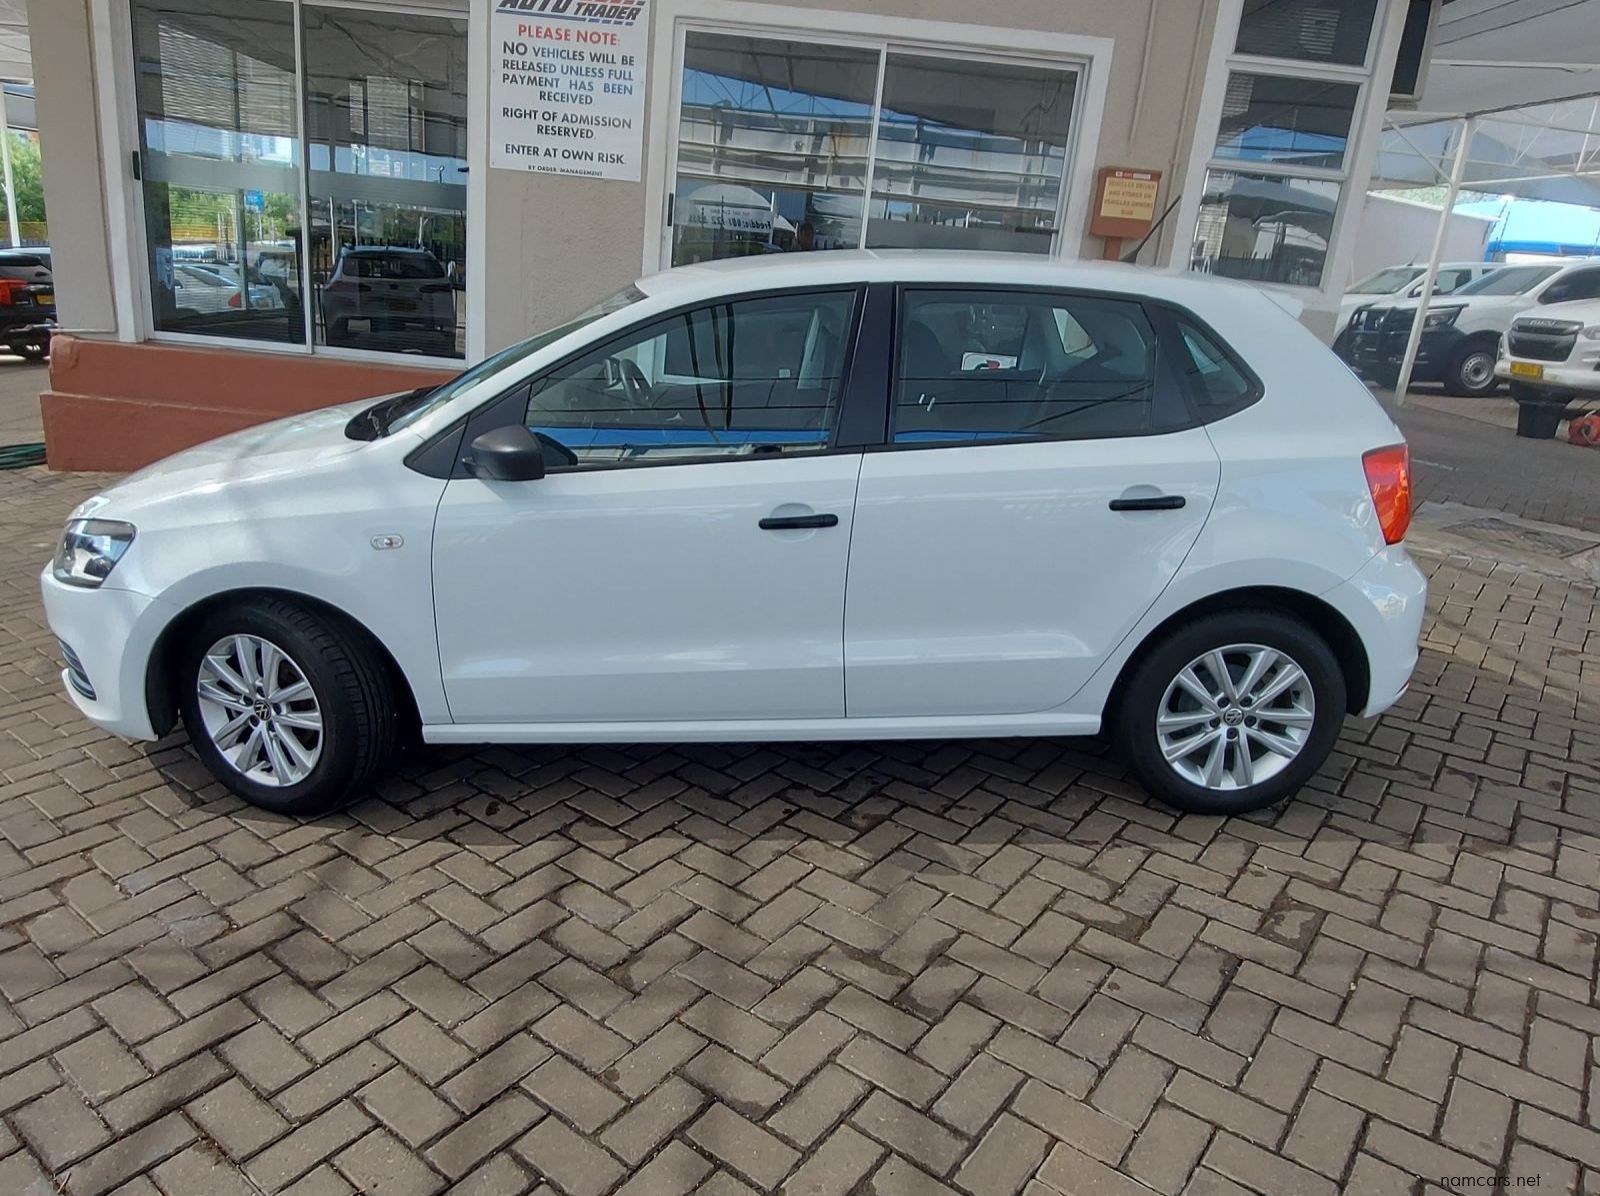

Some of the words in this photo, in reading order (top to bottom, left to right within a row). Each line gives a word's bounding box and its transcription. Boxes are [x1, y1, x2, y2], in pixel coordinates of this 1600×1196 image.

[574, 3, 641, 20] TRADER
[518, 24, 571, 41] PLEASE
[576, 30, 620, 46] NOTE:
[503, 41, 527, 55] NO
[533, 46, 585, 61] VEHICLES
[589, 51, 616, 65] WILL
[621, 55, 635, 66] BE
[502, 59, 557, 73] RELEASED
[561, 64, 604, 79] UNLESS
[608, 69, 634, 81] FULL
[502, 73, 560, 88] PAYMENT
[569, 79, 594, 92] HAS
[603, 82, 633, 95] BEEN
[502, 107, 538, 120] RIGHT
[541, 111, 558, 122] OF
[561, 112, 632, 129] ADMISSION
[505, 143, 540, 157] ENTER
[543, 147, 558, 158] AT
[561, 149, 594, 161] OWN
[560, 167, 603, 177] MANAGEMENT
